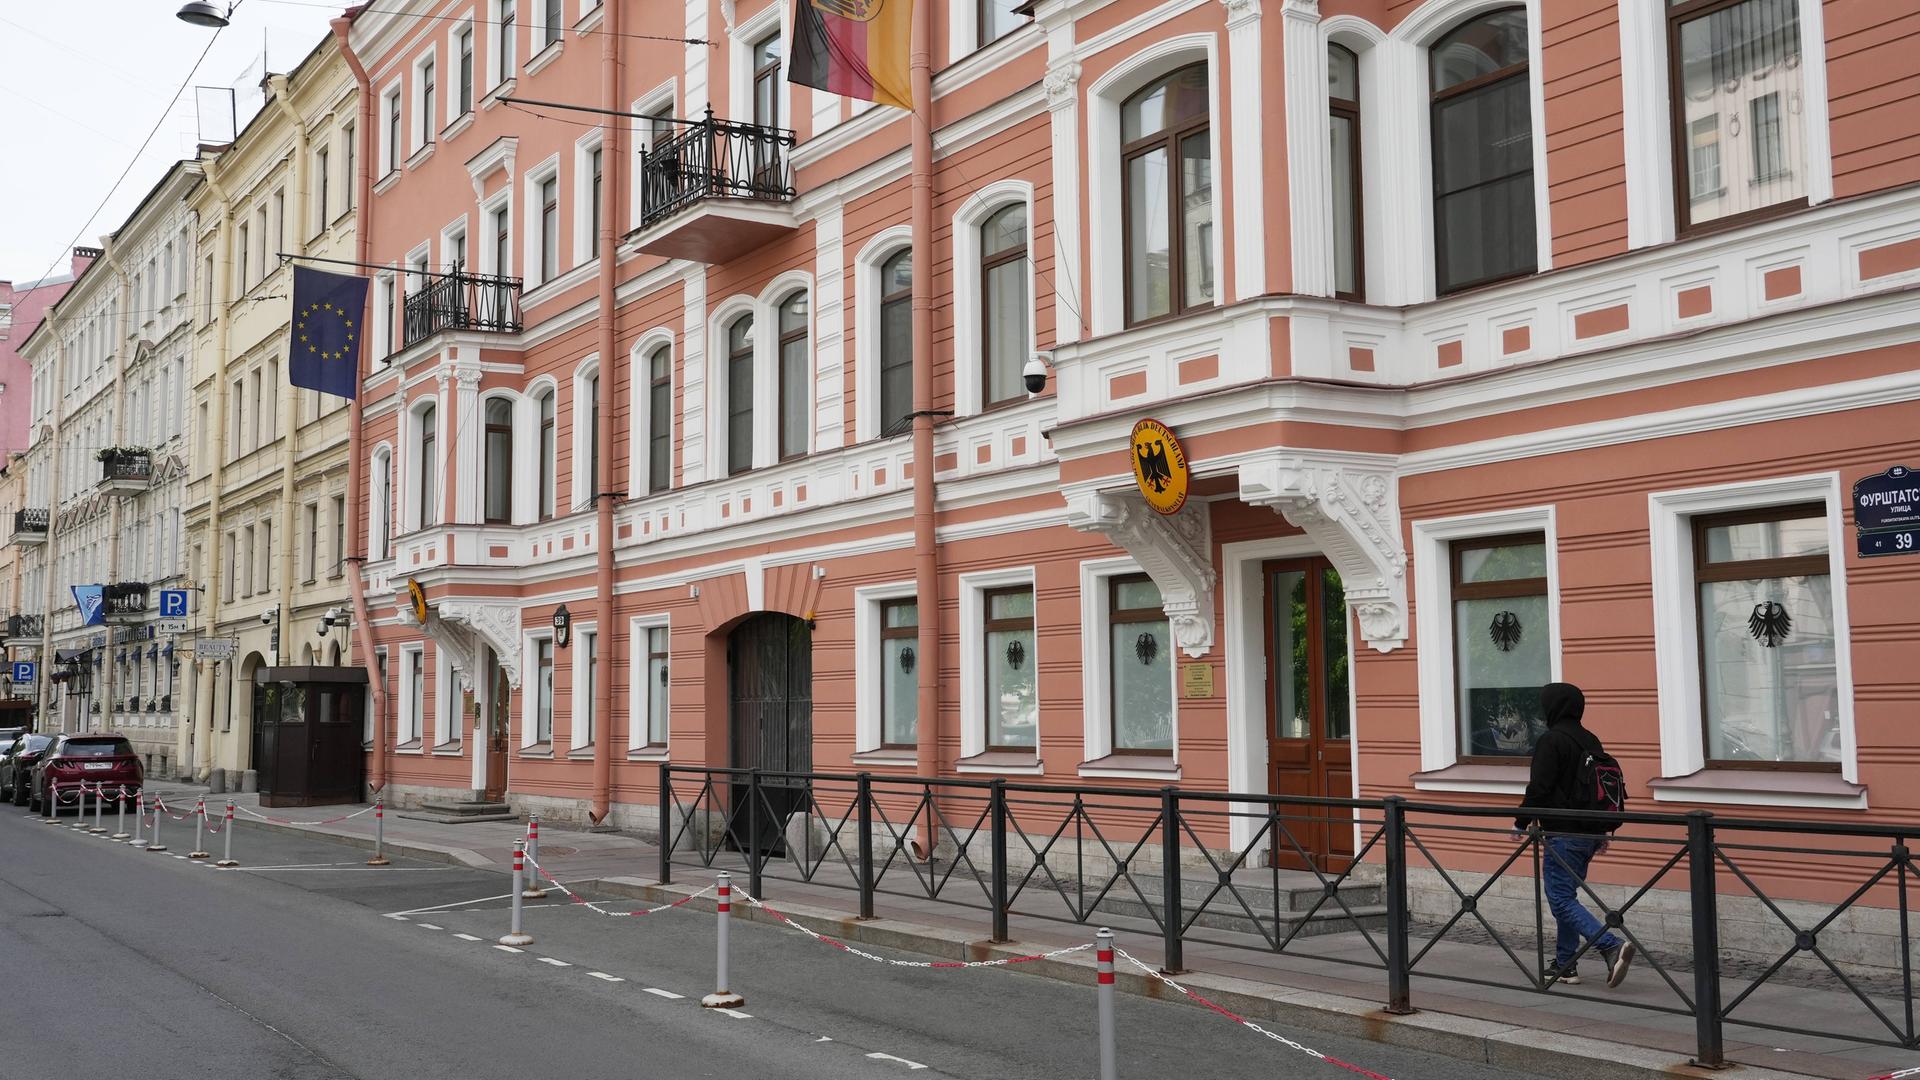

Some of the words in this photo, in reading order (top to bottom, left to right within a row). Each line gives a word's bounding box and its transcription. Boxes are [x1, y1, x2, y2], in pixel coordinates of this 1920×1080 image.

[1860, 488, 1920, 507] ФУРШТАТС
[1890, 505, 1911, 513] УЛИЦА
[1895, 533, 1912, 549] 39
[167, 593, 182, 614] P
